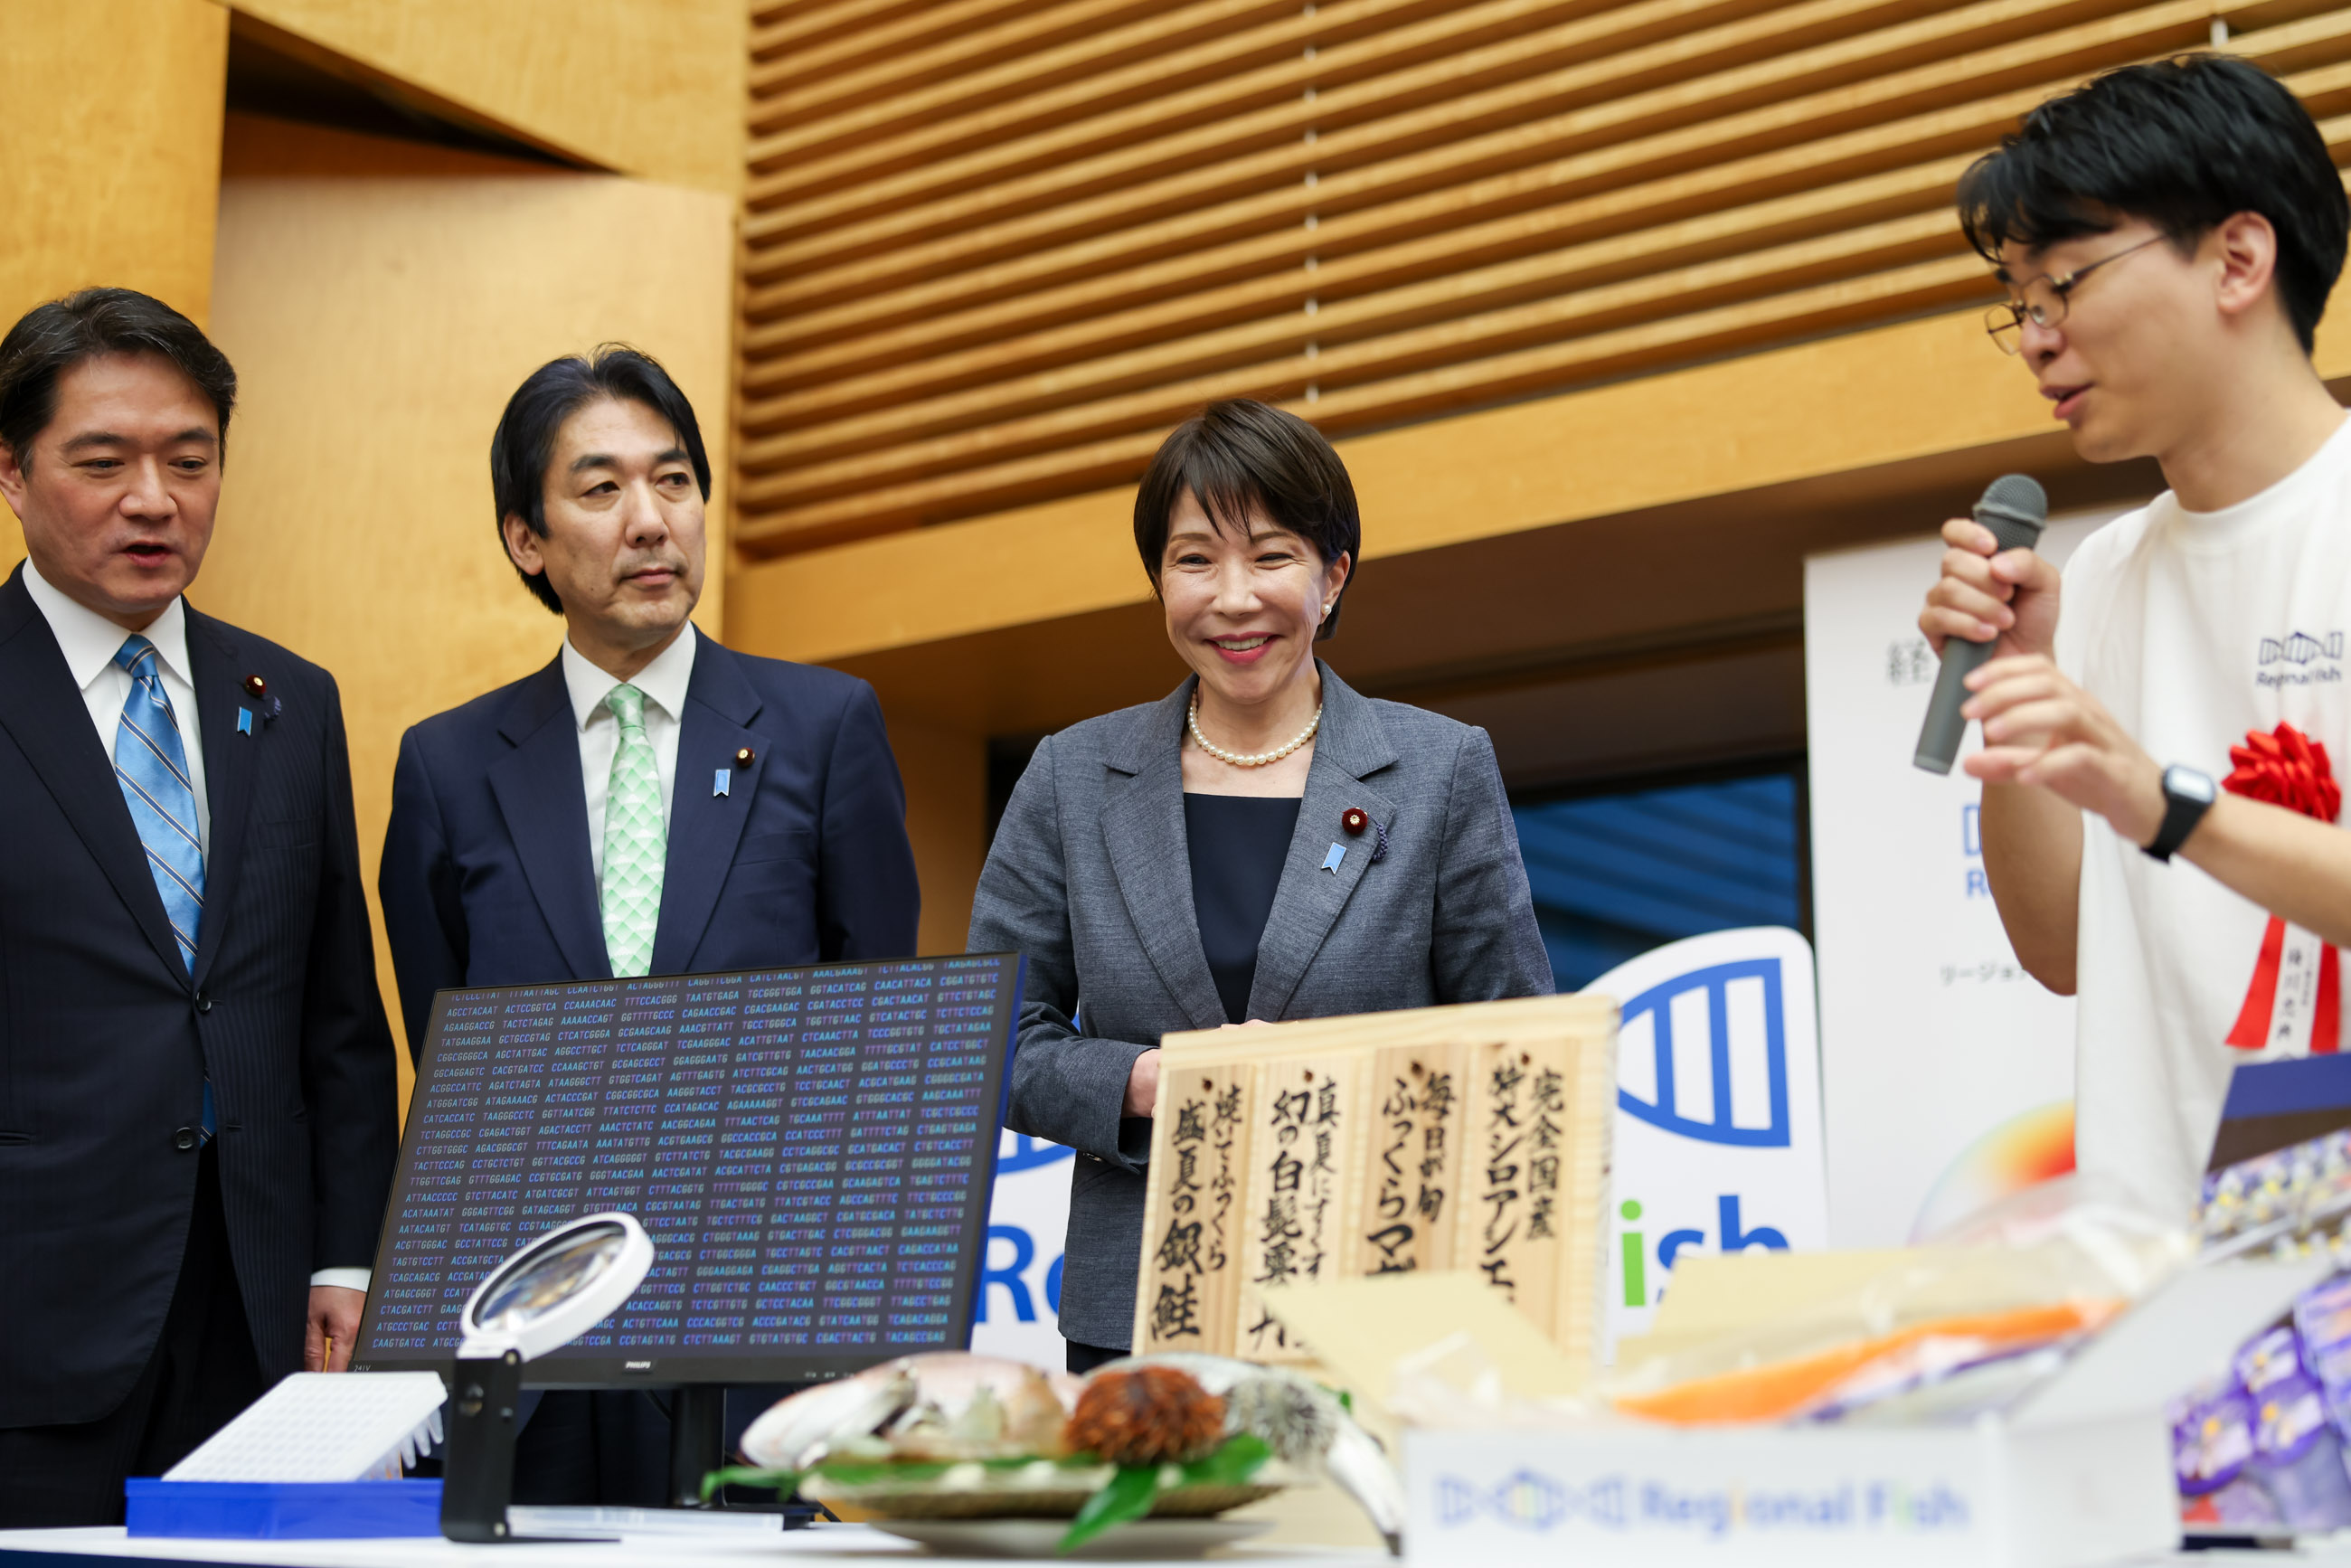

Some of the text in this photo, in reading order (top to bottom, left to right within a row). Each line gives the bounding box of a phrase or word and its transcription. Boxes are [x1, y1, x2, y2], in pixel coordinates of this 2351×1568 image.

[447, 1005, 498, 1015] AGCCTACAAT
[505, 1001, 557, 1013] ACTCCGGTCA
[563, 997, 617, 1009] CCAAAACAAC
[623, 994, 677, 1006] TTTCCACGGG
[685, 990, 739, 1002] TAATGTGAGA
[746, 986, 802, 997] TGCGGGTGGA
[809, 982, 866, 994] GGTACATCAG
[443, 1020, 495, 1031] AGAAGGACCG
[501, 1016, 553, 1028] TACTCTAGAG
[560, 1013, 613, 1025] AAAAACCAGT
[620, 1009, 675, 1021] GGTTTTGCCC
[681, 1006, 736, 1017] CAGAACCGAC
[743, 1002, 799, 1014] CGACGAAGAC
[806, 997, 864, 1010] CGATACCTCC
[439, 1035, 491, 1046] TATGAAGGAA
[498, 1032, 551, 1043] GCTGCCGTAG
[557, 1028, 610, 1040] CTCATCGGGA
[618, 1025, 671, 1036] GCGAAGCAAG
[678, 1021, 733, 1033] AAACGTTATT
[741, 1017, 797, 1029] TGCCTGGGCA
[803, 1014, 861, 1025] TGGTTGTAAC
[437, 1051, 488, 1062] CGGCGGGGCA
[495, 1047, 547, 1058] AGCTATTGAC
[553, 1044, 607, 1055] AGGCCTTGCT
[614, 1040, 668, 1052] TCTCAGGGAT
[675, 1037, 731, 1048] TCGAAGGGAC
[738, 1034, 794, 1045] ACATTGTAAT
[800, 1030, 858, 1042] CTCAAACTTA
[433, 1066, 485, 1077] GGCAGGAGTC
[491, 1063, 543, 1074] CACGTGATCC
[551, 1060, 604, 1071] CCAAAGCTGT
[611, 1056, 665, 1068] GCGAGCGCCT
[672, 1053, 727, 1064] GGAGGGAATG
[734, 1050, 791, 1062] GATCGTTGTG
[798, 1046, 855, 1058] TAACAACGGA
[430, 1082, 481, 1092] ACGGCCATTC
[487, 1079, 541, 1090] AGATCTAGTA
[547, 1075, 600, 1086] ATAAGGGCTT
[608, 1072, 662, 1083] GTGGTCAGAT
[669, 1069, 724, 1081] AGTTTGAGTG
[732, 1066, 788, 1077] ATCTTCGCAG
[795, 1063, 853, 1074] AACTGCATGG
[426, 1097, 477, 1108] ATGGGATCGG
[485, 1094, 537, 1105] ATAGAAAACG
[543, 1091, 598, 1102] ACTACCCGAT
[605, 1089, 659, 1100] CGGCGGCGCA
[666, 1085, 722, 1097] AAGGGTACCT
[729, 1082, 785, 1093] TACGCGCCTG
[792, 1079, 850, 1091] TCCTGCAACT
[422, 1099, 782, 1123] CATCACCATC TAAGGGCCTC GGTTAATCGG TTATCTCTTC CCATAGACAC AGAAAAAGGT
[419, 1115, 779, 1139] TCTAGGCCGC CGAGACTGGT AGACTACCTT AAACTCTATC AACGGCAGAA TTTAACTCAG
[415, 1131, 777, 1155] CTTGGTGGGC AGACGGGCGT TTTCAGAATA AAATATGTTG ACGTGAAGCG GGCCACCGCA
[411, 1148, 774, 1170] TACTTCCCAG CCTGCTCTGT GGTTACGCCG ATCAGGGGGT GTCTTATCTG TACGCGAAGG
[409, 1164, 770, 1186] TTGGTTCGAG GTTTGGAGAC CCGTGCGATG GGGTAACGAA AACTCGATAT ACGCATTCTA
[1481, 1062, 1526, 1302] 特大シロアシエ
[405, 1181, 768, 1202] ATTAACCCCC GTCTTACATC ATGATCGCGT ATTCAGTGGT CTTTACGGTG TTTTTGGGGC
[401, 1208, 454, 1218] ACATAAATAT
[460, 1205, 514, 1216] GGGAGTTCGG
[520, 1204, 575, 1214] GATAGCAGGT
[644, 1200, 700, 1211] CGCGTAATAG
[708, 1197, 765, 1208] TTGACTGATG
[398, 1223, 450, 1233] AATACAATGT
[457, 1222, 510, 1232] TCATAGGTGC
[704, 1214, 762, 1225] TGCTCTTTCG
[1151, 1099, 1204, 1340] 盛夏の銀鮭
[394, 1232, 759, 1250] ACGTTGGGAC GCCTATTCCG CTGGGTAAAG
[390, 1256, 443, 1267] TAGTGTCCTT
[698, 1249, 756, 1260] CTTGGCGGGA
[387, 1265, 753, 1282] TCAGCAGACG GGGAAGGAGA
[382, 1282, 751, 1299] ATGAGCGGGT CTTGGTCTGC
[379, 1299, 747, 1315] CTACGATCTT ACACCAGGTG TCTCGTTGTG
[375, 1317, 744, 1332] ATGCCCTGAC ACTGTTCAAA CCCACGGTCG
[372, 1334, 741, 1348] CAAGTGATCC CCGTAGTATG CTCTTAAAGT
